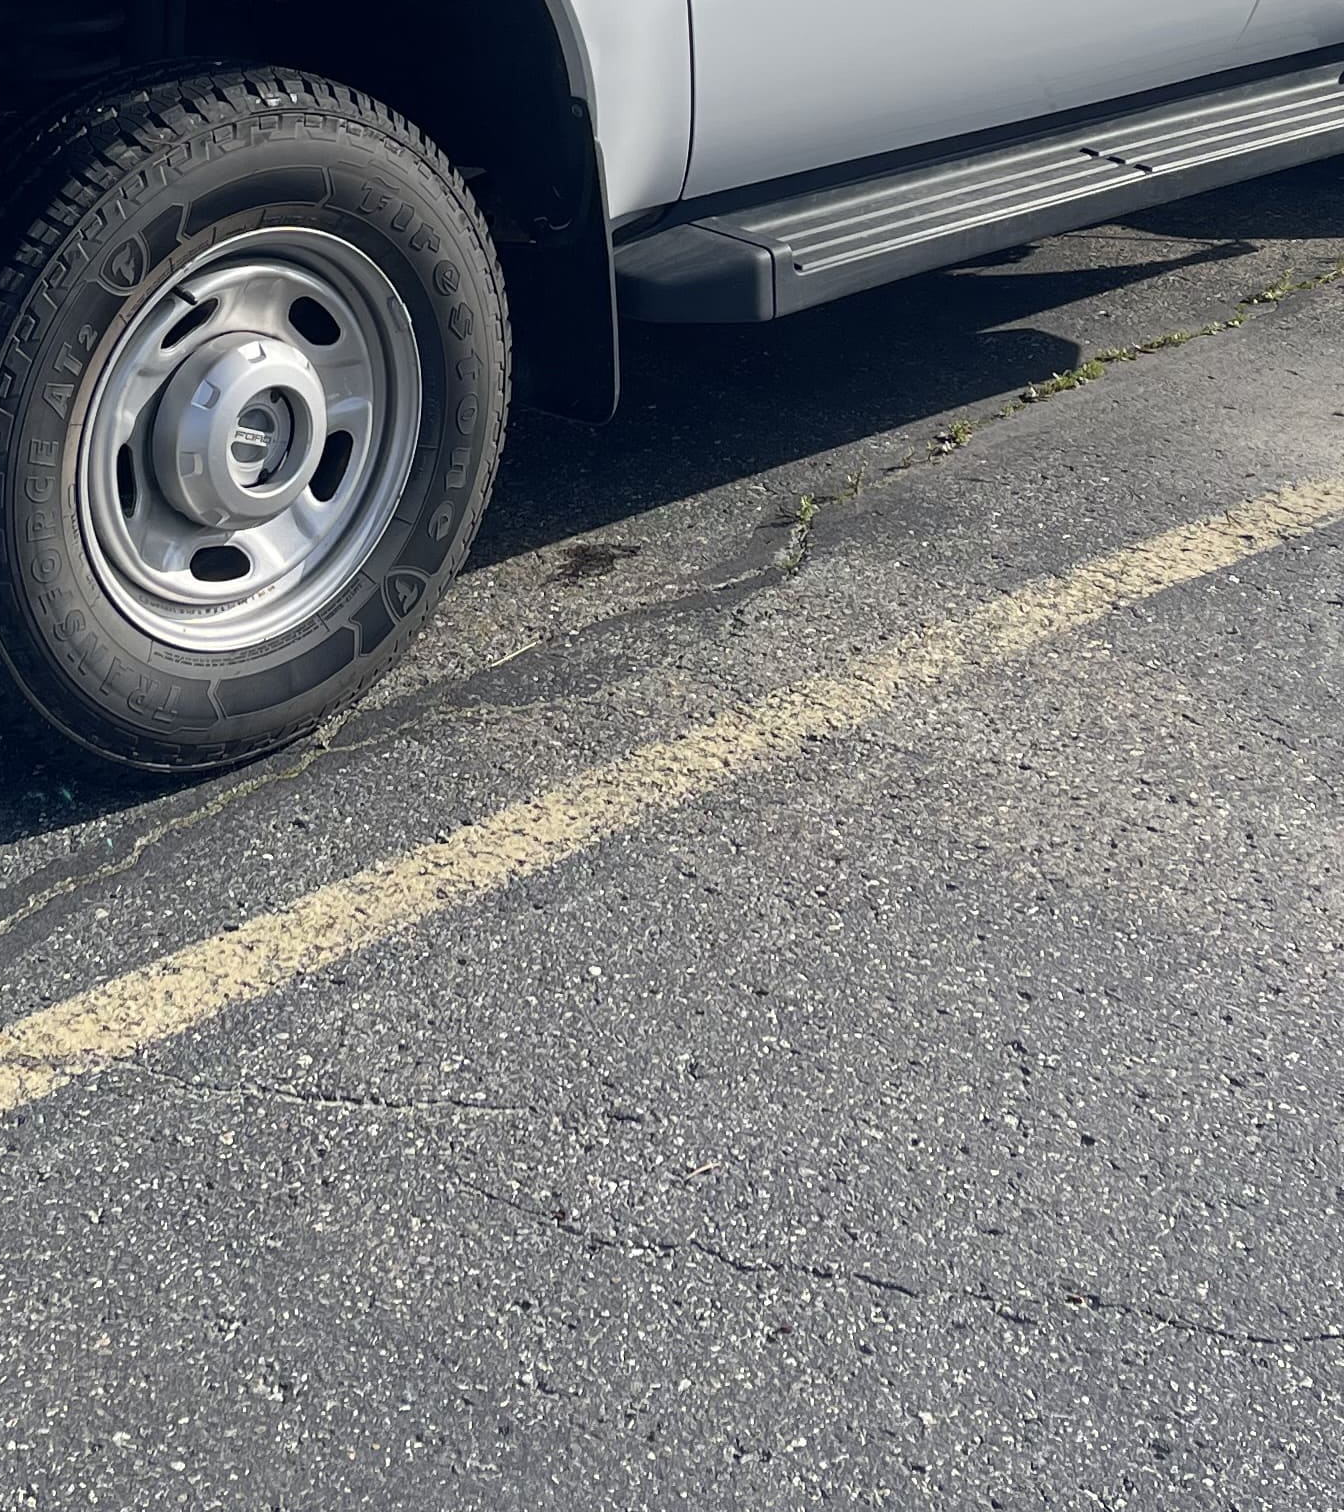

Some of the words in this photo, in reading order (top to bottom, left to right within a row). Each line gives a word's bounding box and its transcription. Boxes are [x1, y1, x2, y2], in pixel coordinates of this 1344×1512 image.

[235, 430, 272, 444] FORD
[359, 176, 480, 542] Firestone
[25, 438, 182, 726] TRANSFORCE
